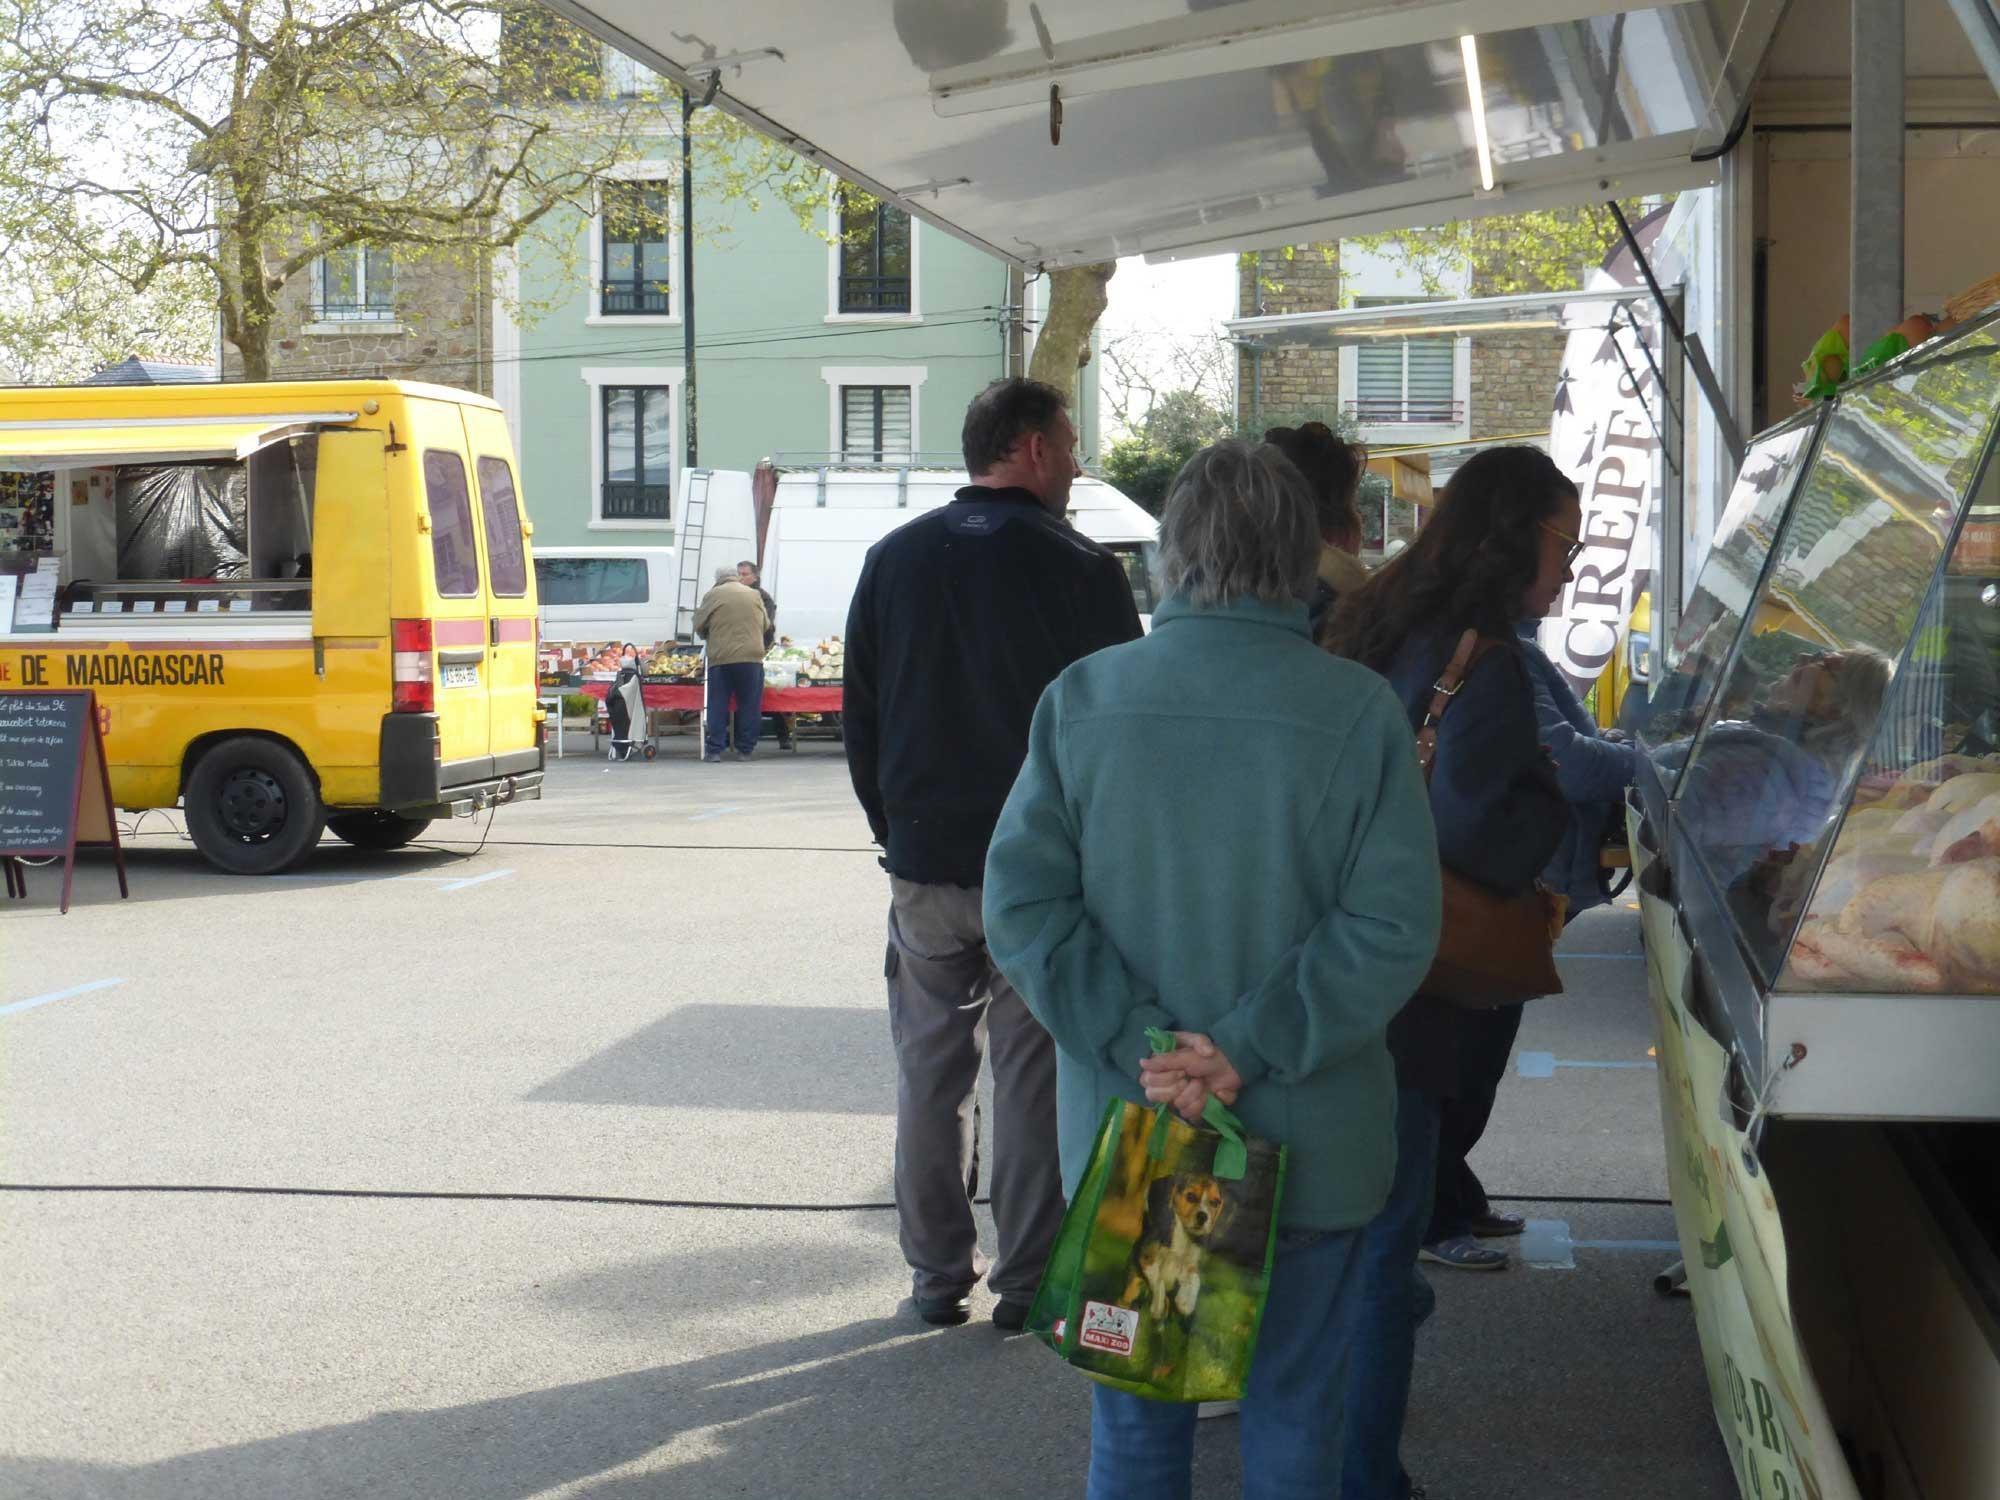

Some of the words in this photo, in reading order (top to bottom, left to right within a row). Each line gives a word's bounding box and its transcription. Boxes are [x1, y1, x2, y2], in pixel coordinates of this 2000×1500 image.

[1564, 366, 1658, 669] CREPES
[21, 655, 48, 686] DE
[66, 654, 225, 686] MADAGASCAR
[1085, 1332, 1110, 1346] MAXI
[1111, 1339, 1129, 1349] ZOO
